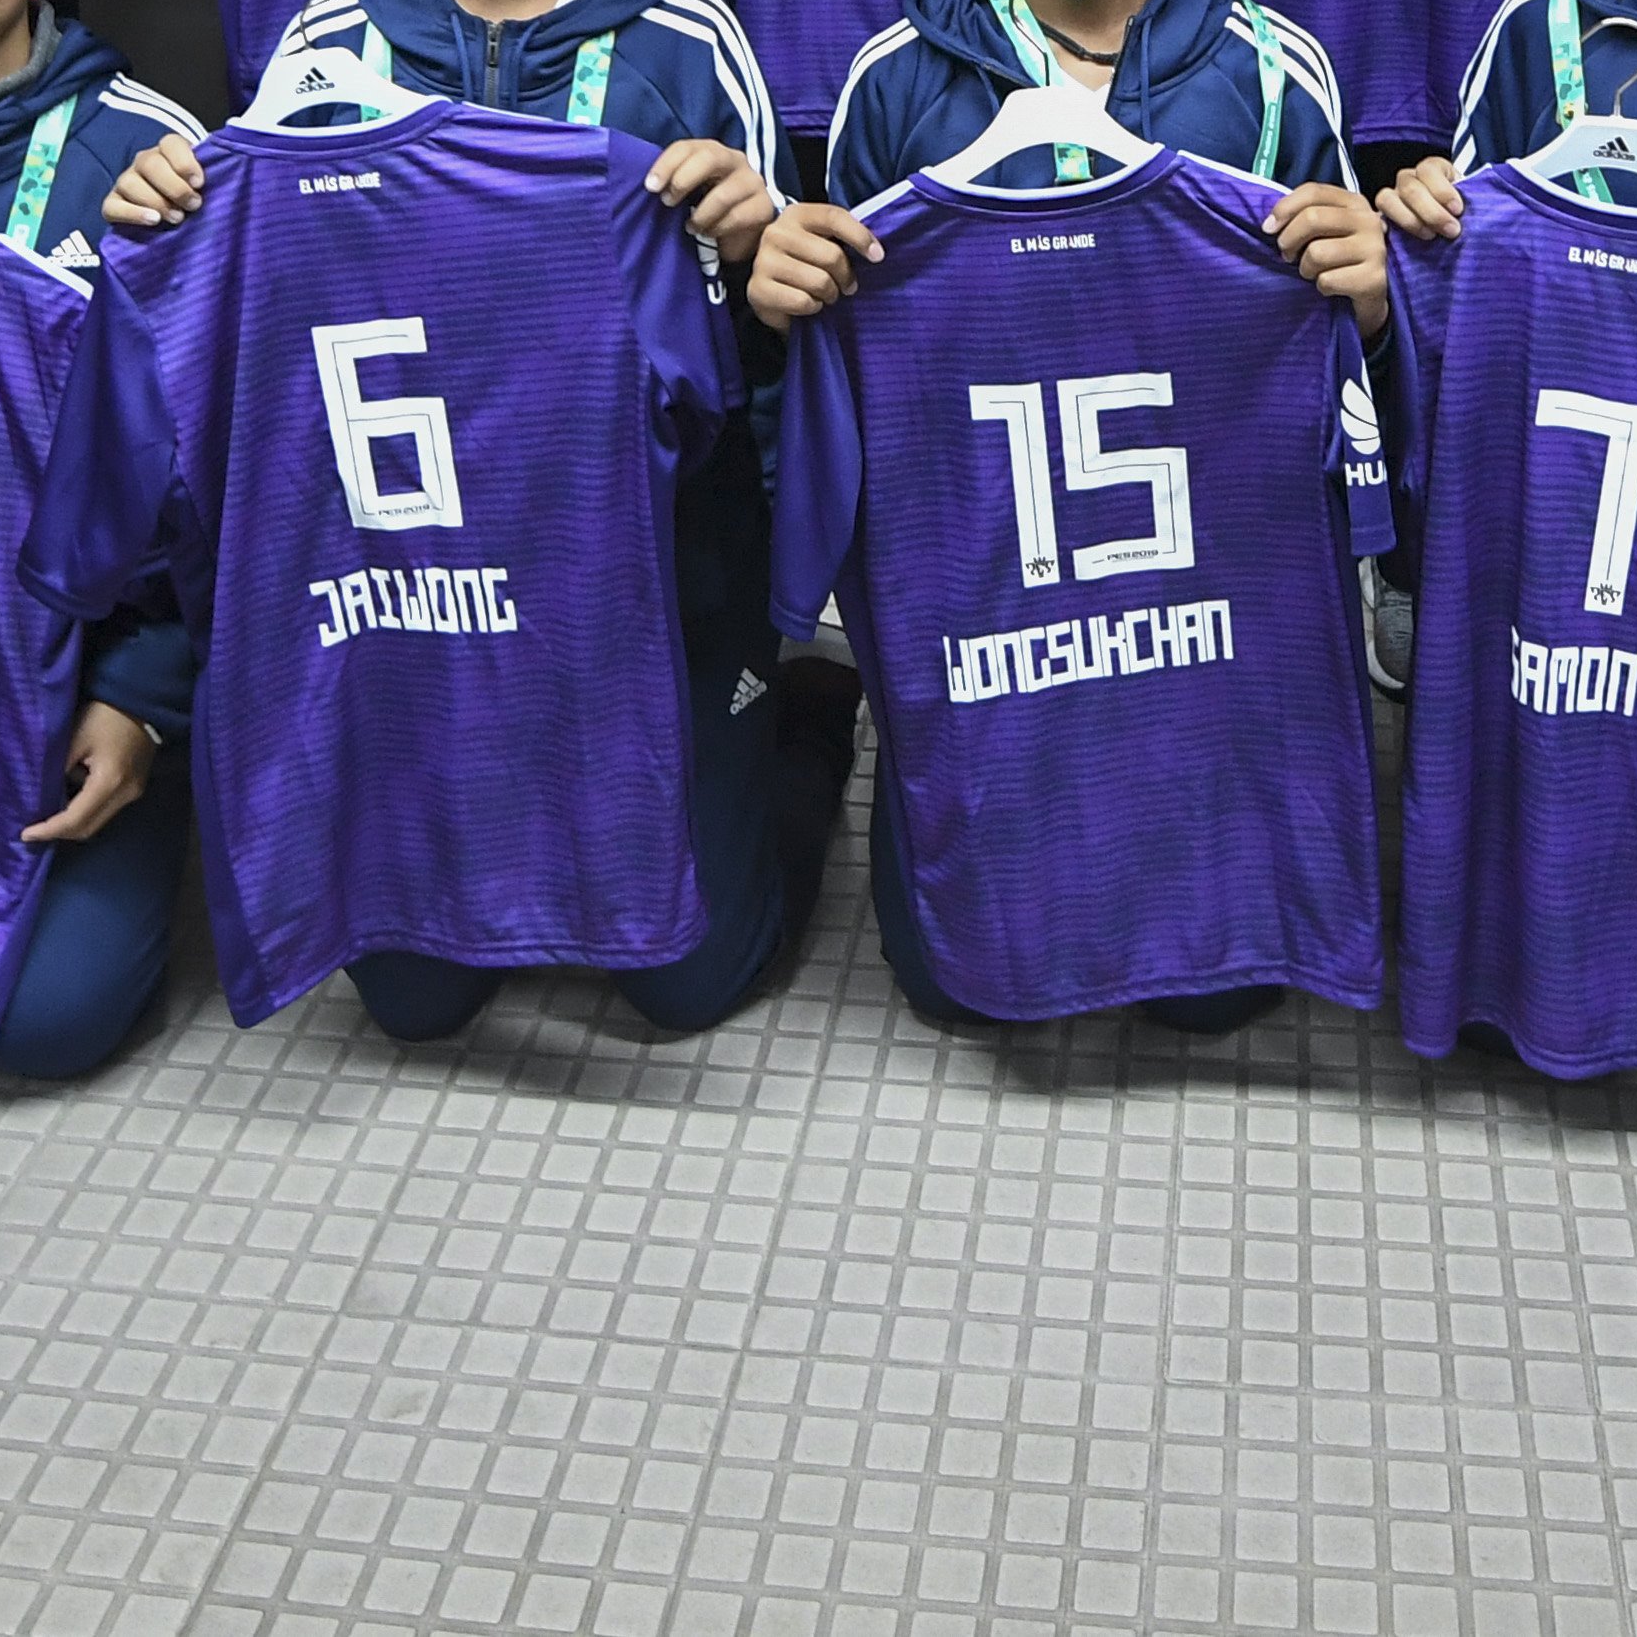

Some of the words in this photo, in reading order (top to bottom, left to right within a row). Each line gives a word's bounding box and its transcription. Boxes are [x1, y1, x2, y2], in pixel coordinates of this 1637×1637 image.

[1592, 149, 1636, 162] adidas
[298, 178, 314, 195] EL
[338, 171, 382, 191] GRANDE
[1010, 238, 1025, 254] EL
[1052, 233, 1096, 251] GRANDE
[1568, 246, 1582, 263] EL
[310, 316, 464, 531] 6
[968, 371, 1195, 588] 15
[308, 566, 518, 648] JAIWONG
[942, 598, 1235, 703] WONGSUKCHAN
